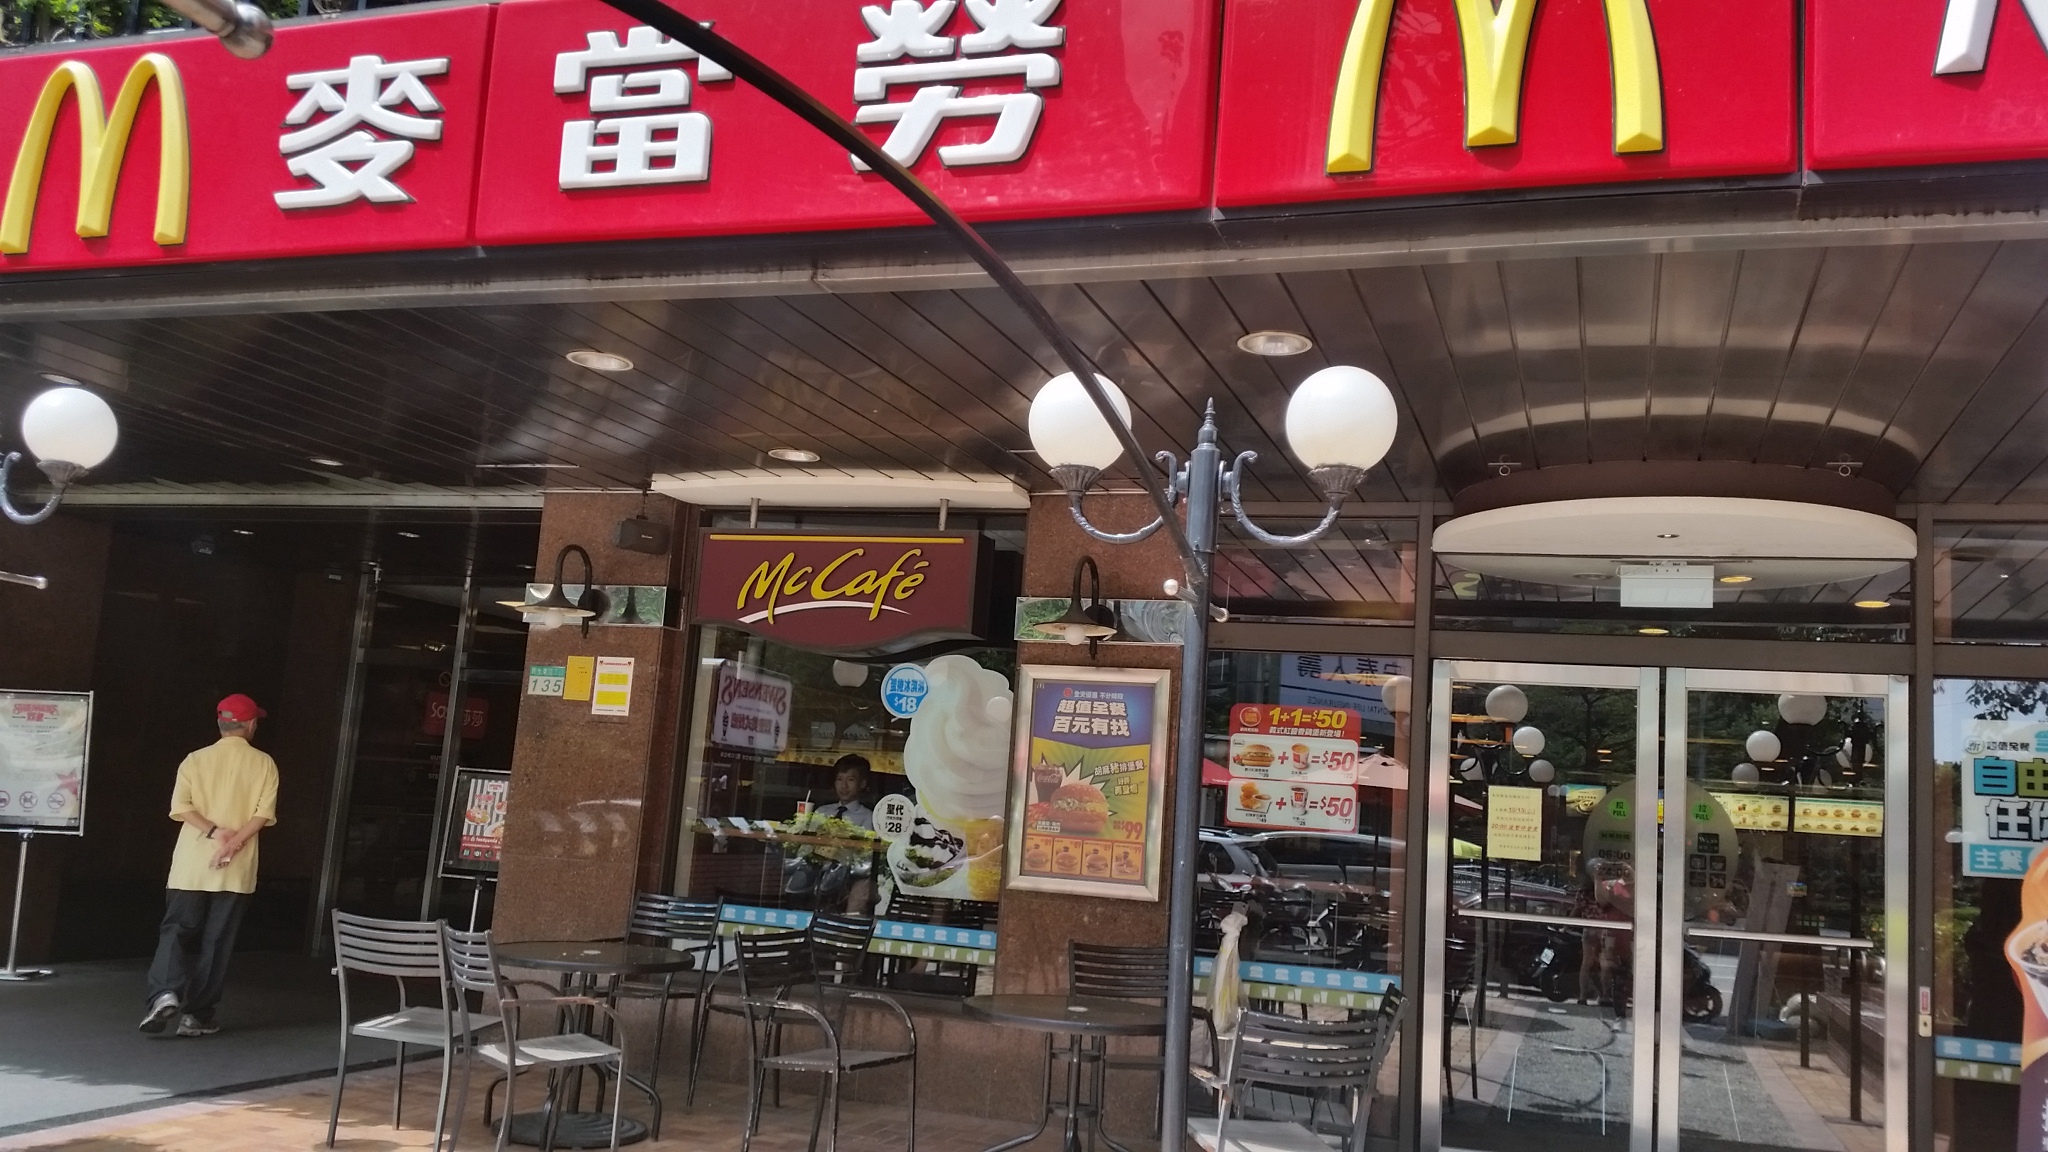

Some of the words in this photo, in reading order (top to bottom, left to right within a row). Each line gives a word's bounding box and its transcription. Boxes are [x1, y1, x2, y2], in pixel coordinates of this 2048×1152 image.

[274, 0, 1067, 210] 麥當勞
[737, 548, 930, 625] McCafé
[532, 679, 562, 692] 135
[894, 696, 917, 712] $18
[1057, 699, 1127, 716] 超值全餐
[1052, 715, 1130, 737] 百元有找
[886, 803, 904, 815] 聖代
[1319, 797, 1353, 818] $50
[1613, 809, 1626, 817] PULL
[884, 821, 902, 833] $28
[1598, 849, 1630, 860] 06:00
[1974, 848, 2023, 872] 主餐
